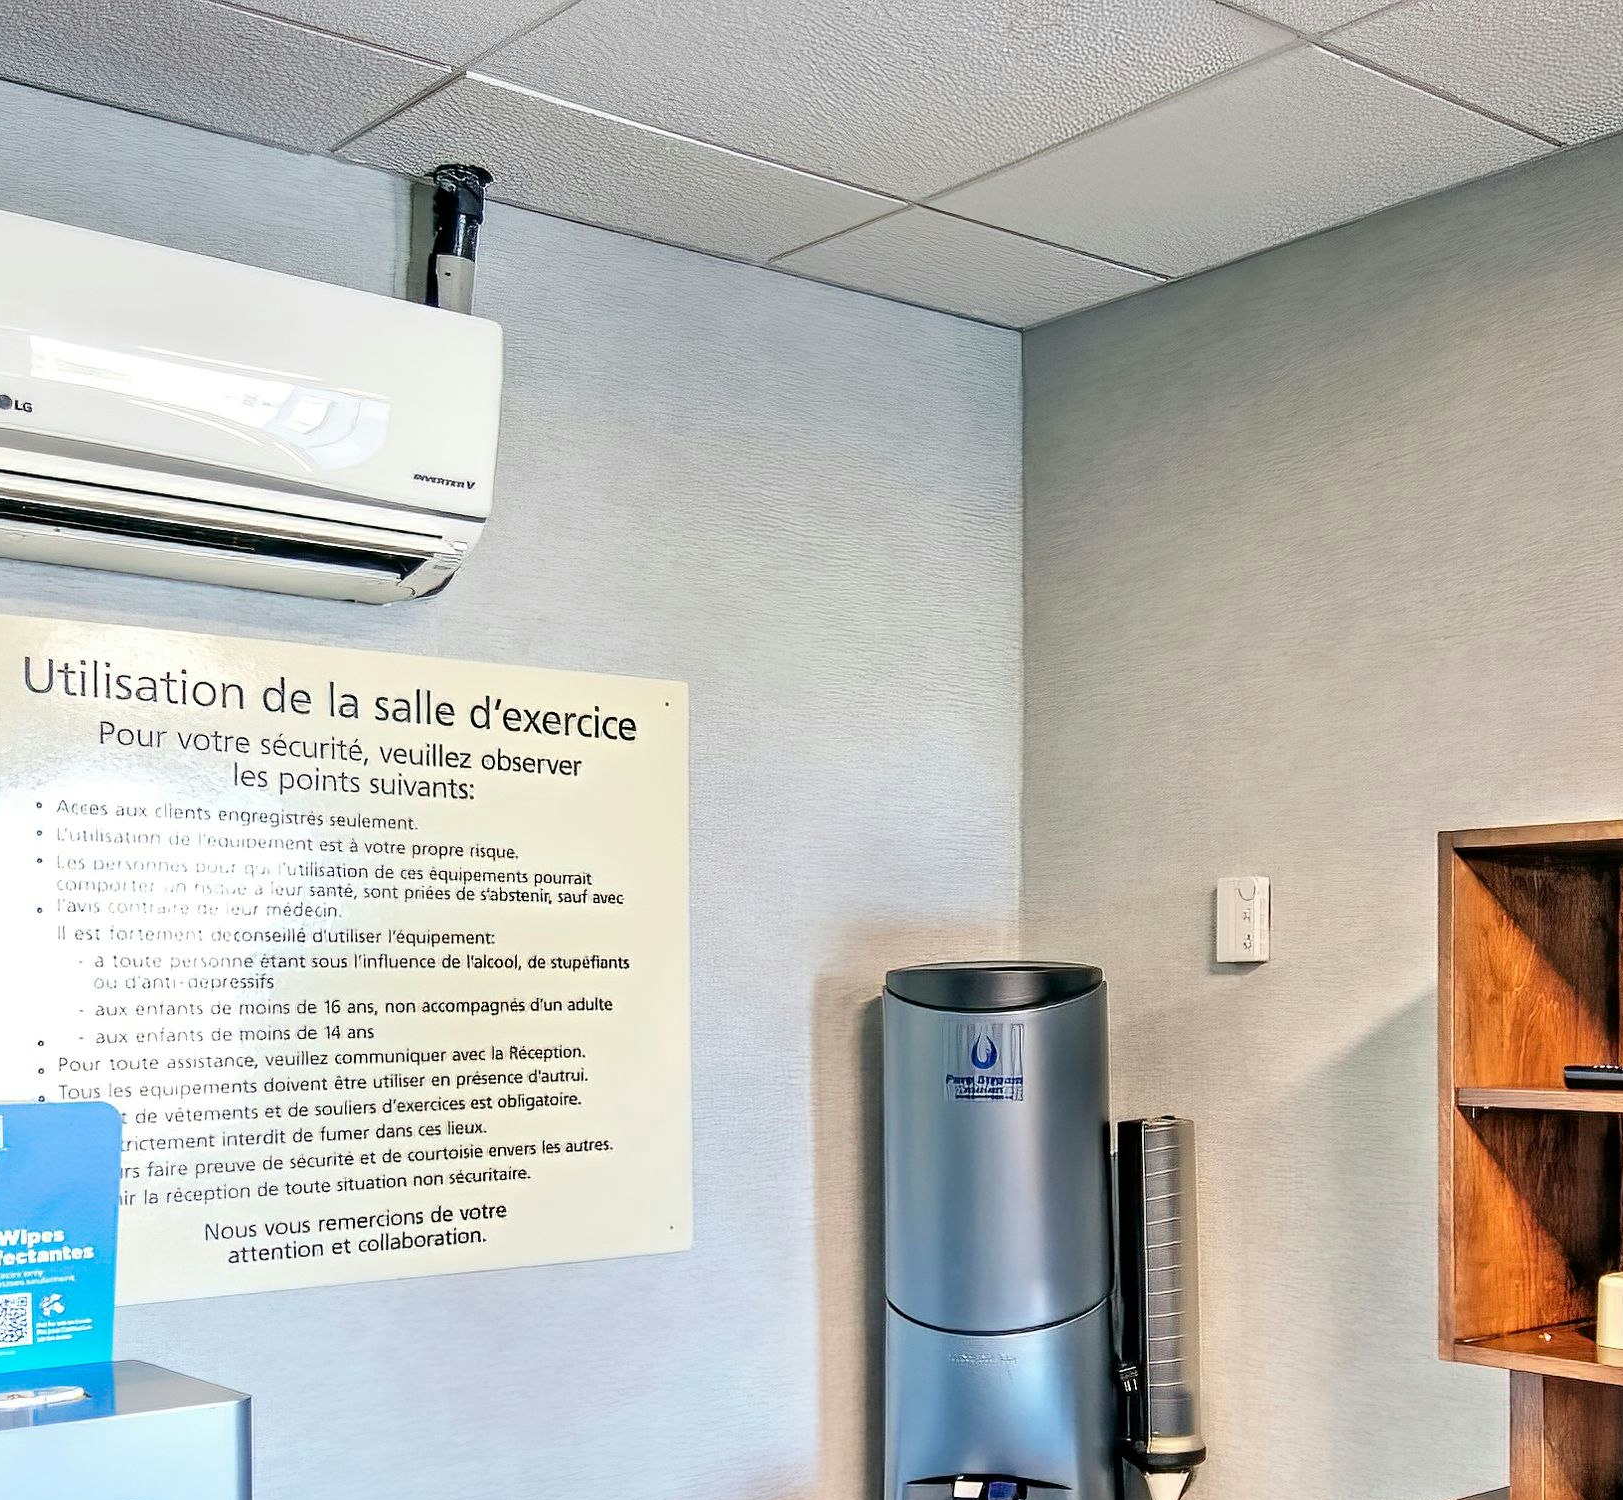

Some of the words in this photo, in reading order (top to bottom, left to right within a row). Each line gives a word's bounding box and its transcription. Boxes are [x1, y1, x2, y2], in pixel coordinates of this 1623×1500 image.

[15, 399, 32, 412] LG
[25, 657, 244, 709] Utilisation
[263, 677, 311, 714] de
[330, 682, 358, 718] la
[375, 689, 455, 726] salle
[470, 696, 636, 741] d'exercice
[100, 720, 167, 747] Pour
[178, 730, 250, 753] votre
[261, 733, 368, 766] sécurité,
[380, 743, 471, 768] veuillez
[482, 747, 582, 776] observer
[235, 761, 267, 787] les
[280, 767, 360, 795] points
[370, 772, 474, 799] suivants:
[59, 1056, 101, 1071] Pour
[110, 1057, 159, 1070] toute
[167, 1054, 258, 1069] assistance,
[265, 1050, 328, 1066] veuillez
[335, 1049, 446, 1065] communiquer
[452, 1045, 486, 1061] avec
[492, 1045, 503, 1060] la
[510, 1045, 585, 1062] Réception.
[58, 1084, 100, 1099] Tous
[109, 1082, 131, 1097] les
[264, 1077, 327, 1092] doivent
[335, 1075, 366, 1089] être
[374, 1073, 425, 1088] utiliser
[431, 1074, 450, 1086] en
[457, 1071, 523, 1088] présence
[205, 1222, 256, 1240] Nous
[265, 1220, 310, 1235] vous
[319, 1208, 423, 1232] remercions
[431, 1205, 453, 1222] de
[460, 1204, 506, 1220] votre
[228, 1240, 323, 1263] attention
[332, 1238, 351, 1254] et
[359, 1227, 486, 1252] collaboration.
